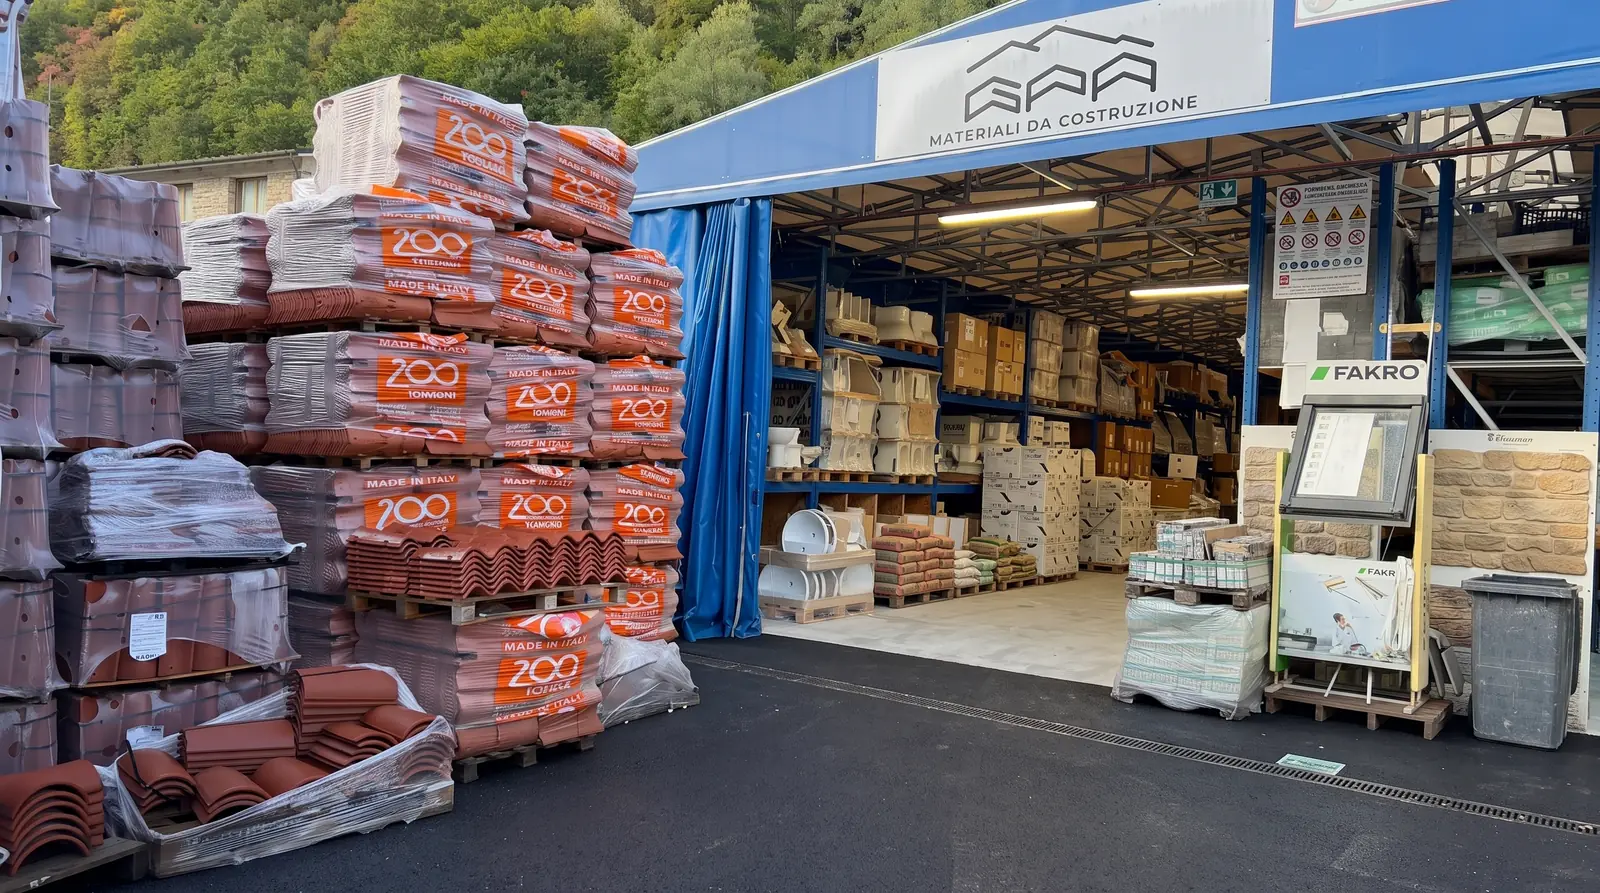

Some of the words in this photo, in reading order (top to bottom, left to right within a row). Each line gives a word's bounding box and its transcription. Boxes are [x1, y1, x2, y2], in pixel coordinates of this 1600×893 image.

[930, 122, 1020, 147] MATERIALI
[1027, 117, 1052, 133] DA
[1059, 95, 1198, 127] COSTRUZIONE
[445, 114, 507, 160] 200
[392, 228, 468, 257] 200
[505, 255, 536, 269] MADE
[388, 280, 424, 290] MADE
[427, 282, 440, 291] IN
[442, 284, 470, 294] ITALY
[615, 273, 642, 283] MADE
[643, 277, 652, 285] IN
[510, 273, 568, 303] 200
[620, 289, 667, 313] 200
[379, 338, 418, 350] MADE
[385, 358, 460, 388] 200
[509, 370, 539, 378] MADE
[1334, 364, 1420, 381] FAKRO
[612, 384, 639, 392] MADE
[618, 399, 667, 421] 200
[536, 439, 546, 447] IN
[548, 440, 571, 448] ITALY
[367, 478, 406, 488] MADE
[410, 477, 424, 486] IN
[427, 475, 456, 484] ITALY
[618, 488, 644, 497] MADE
[375, 493, 450, 531] 200
[508, 494, 567, 520] 200
[618, 503, 665, 527] 200
[1368, 568, 1396, 577] FAKR
[504, 641, 543, 651] MADE
[546, 640, 558, 649] IN
[561, 634, 588, 648] ITALY
[508, 653, 579, 688] 200
